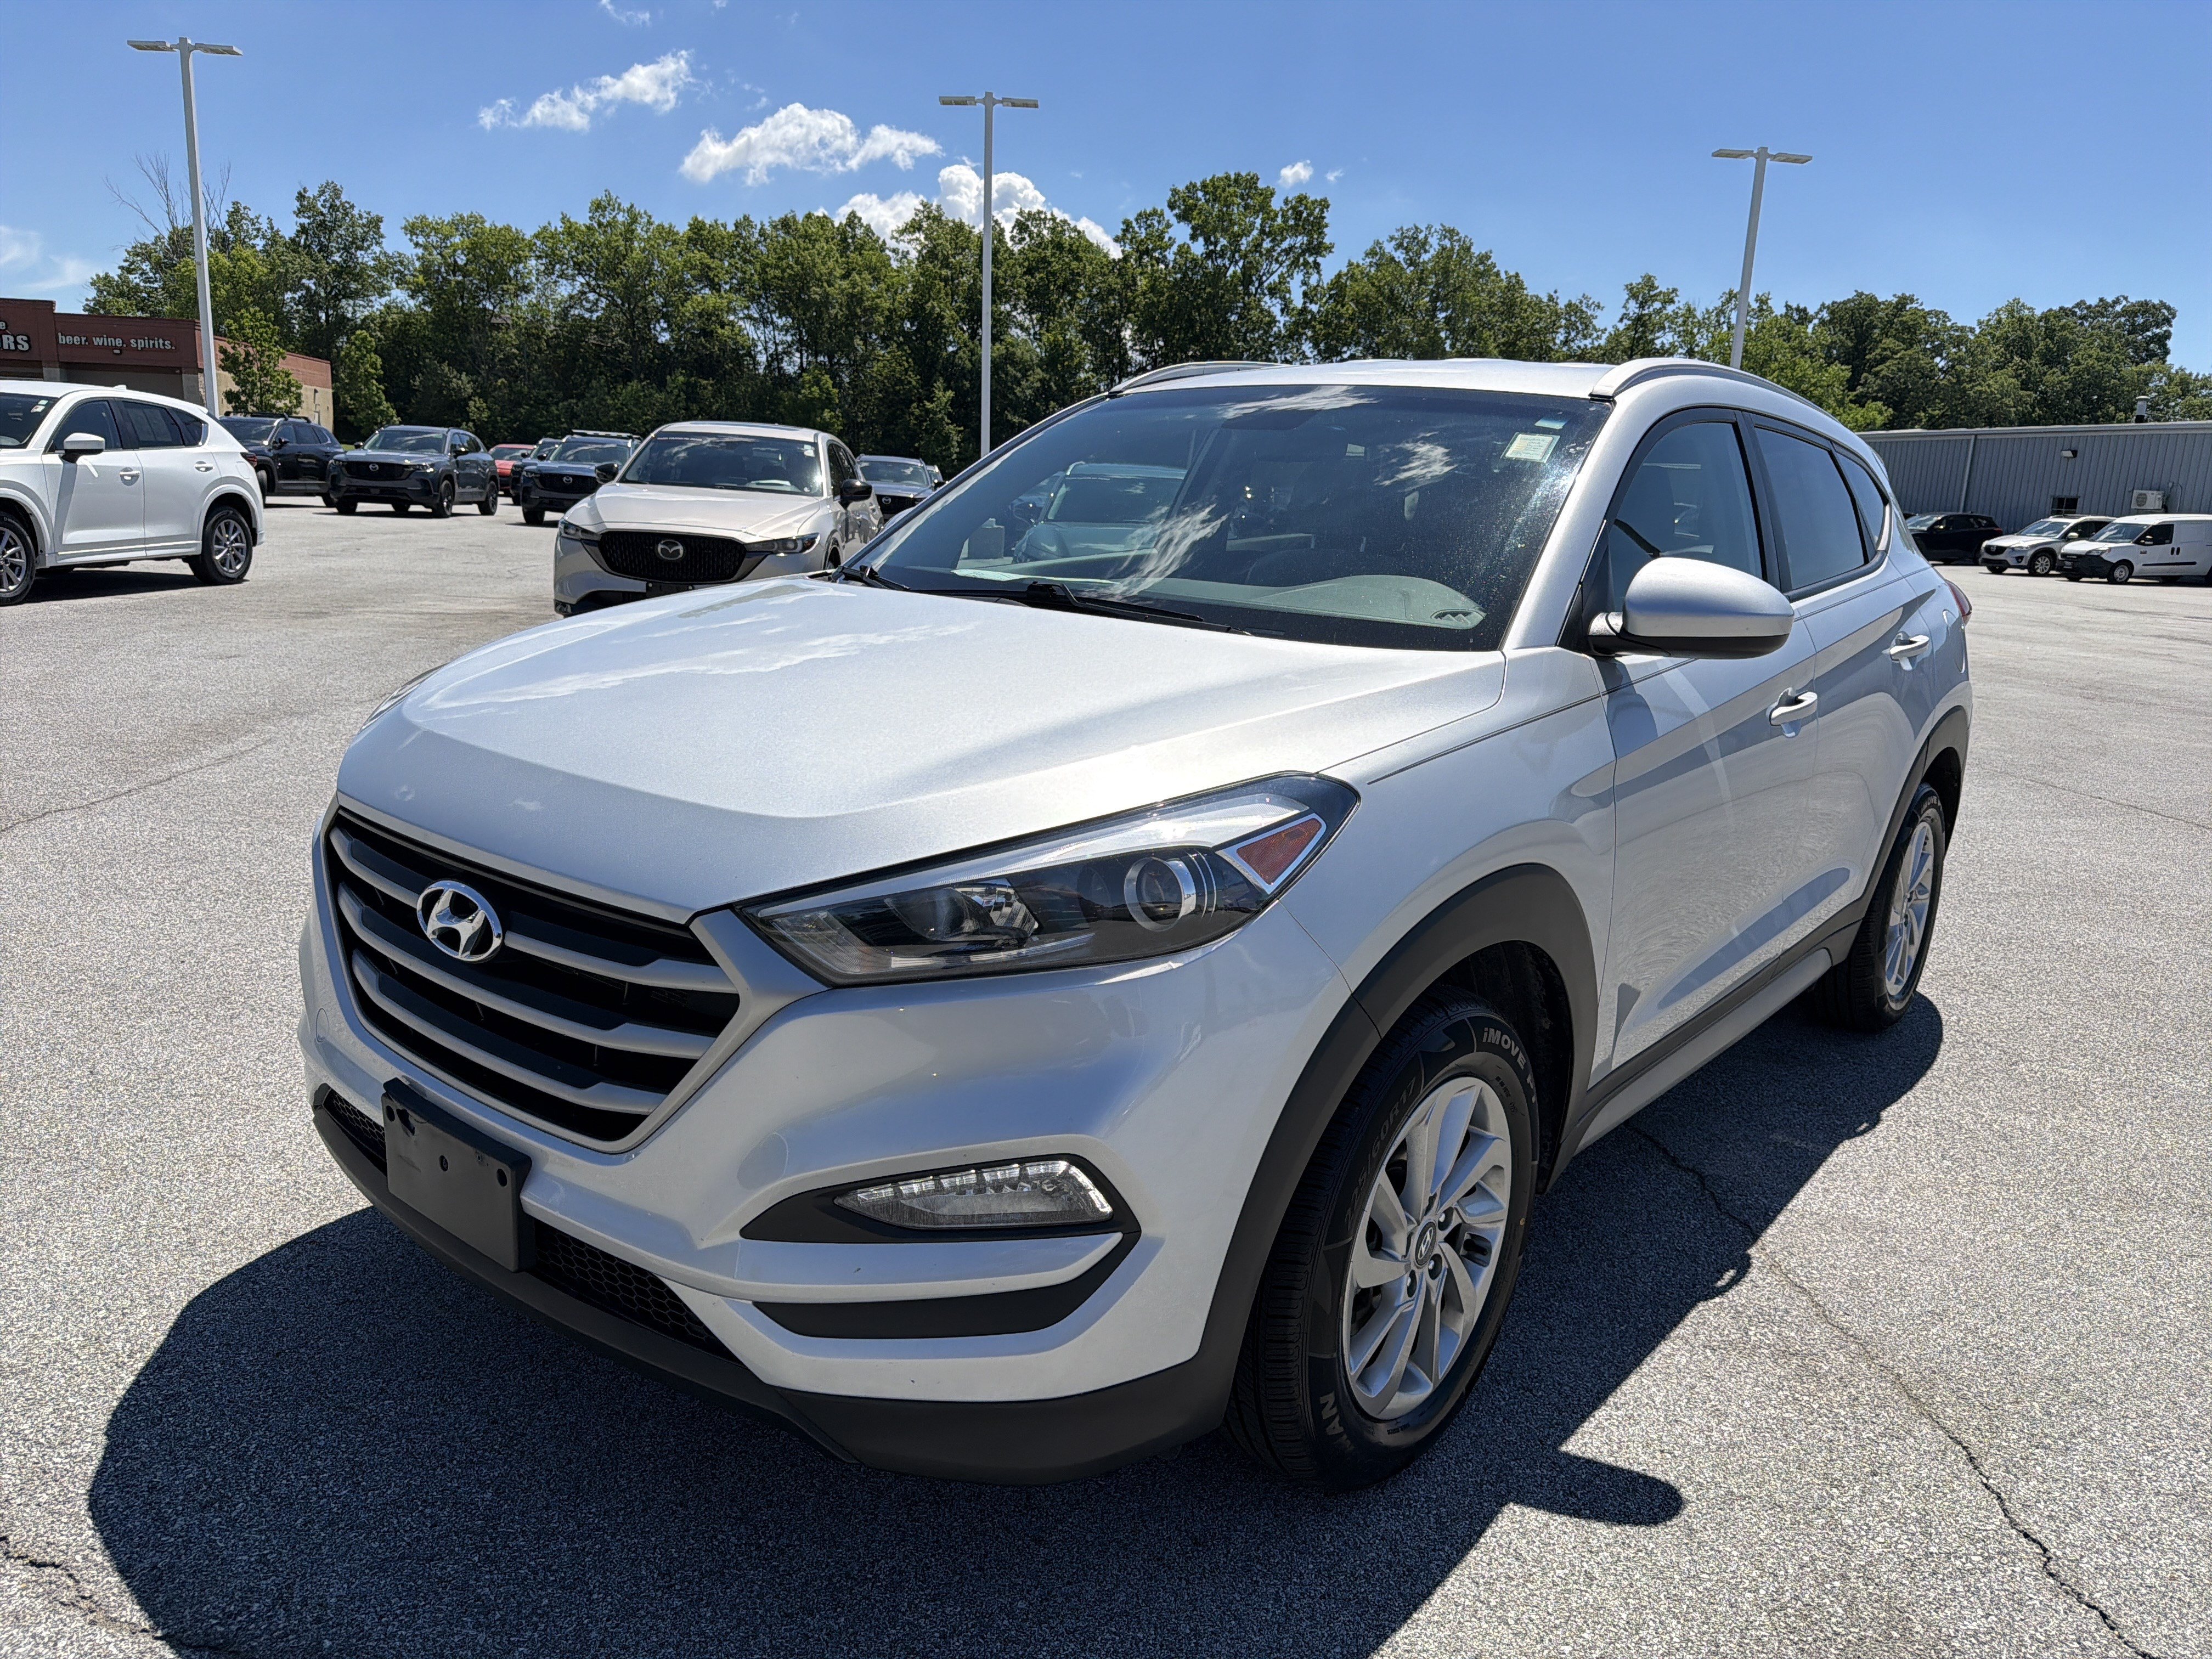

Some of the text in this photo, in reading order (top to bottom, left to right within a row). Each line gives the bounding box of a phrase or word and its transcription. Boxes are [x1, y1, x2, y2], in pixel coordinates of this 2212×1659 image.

[0, 334, 29, 351] RS
[58, 332, 176, 351] beer. wine. spirits.
[1482, 1027, 1526, 1070] iMOVE
[1344, 1075, 1417, 1232] 225/60R17
